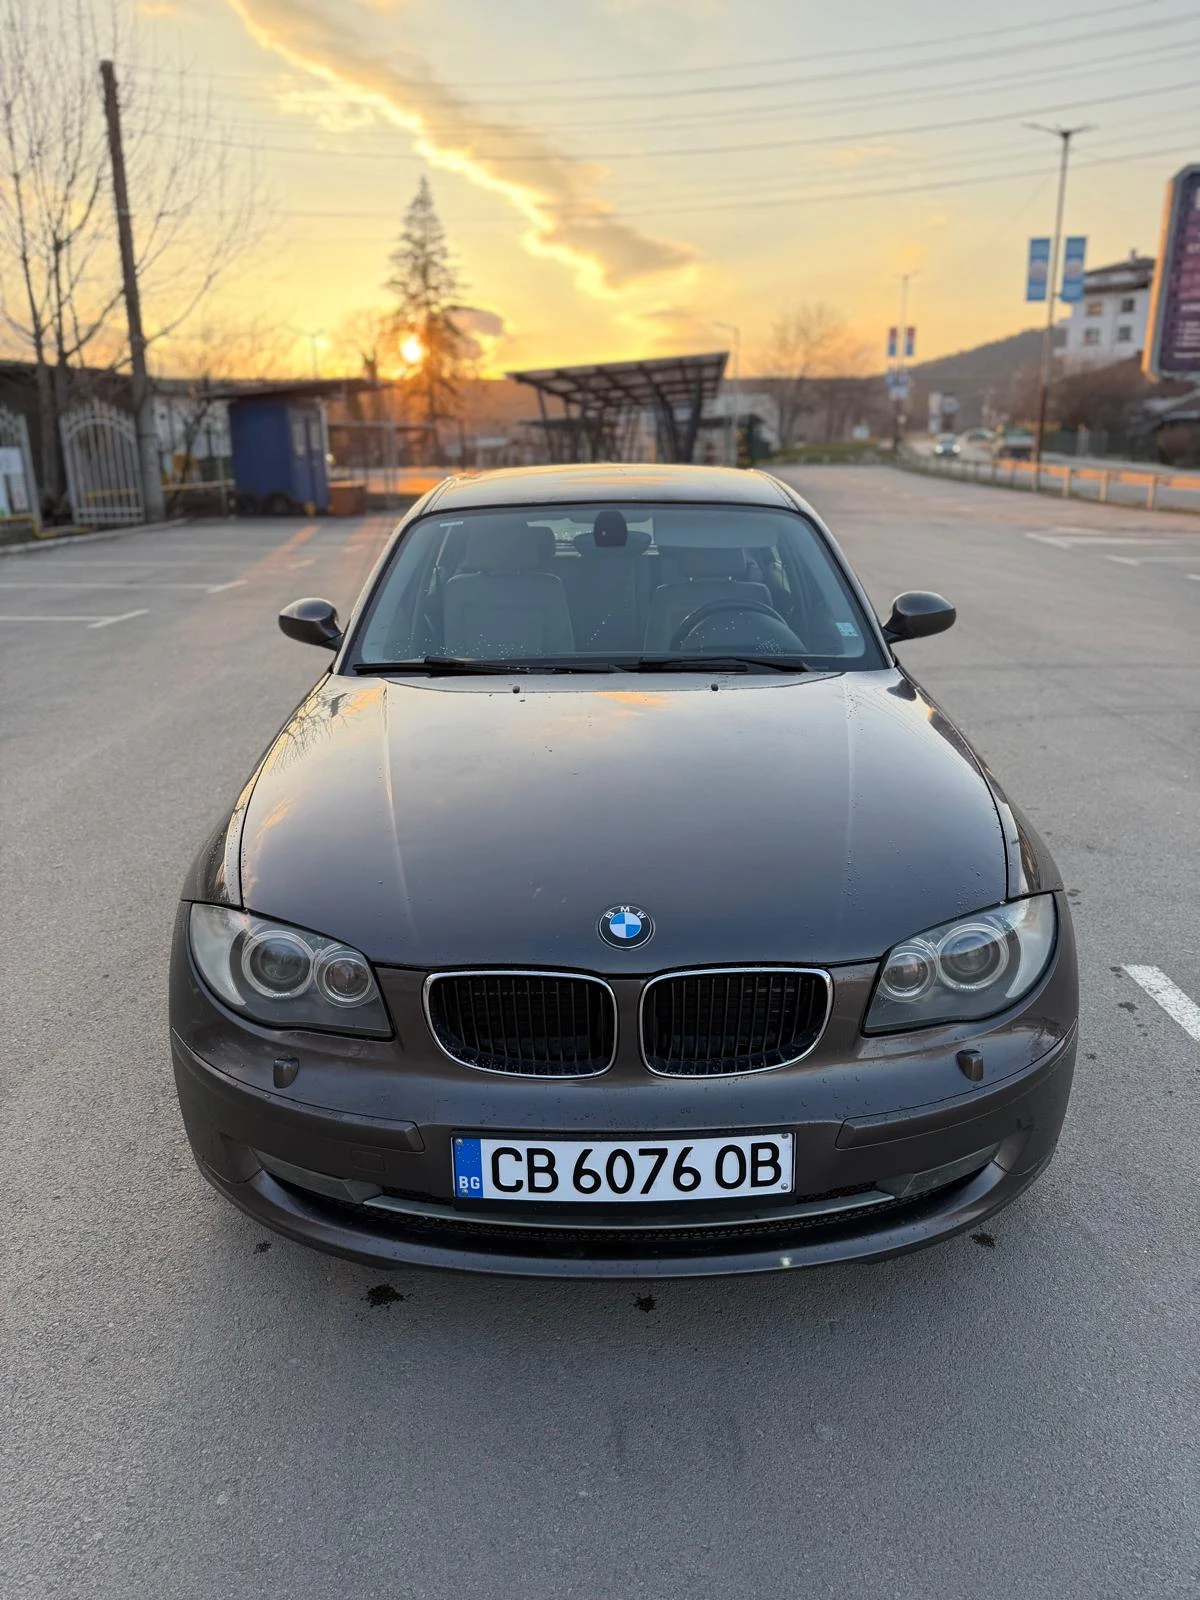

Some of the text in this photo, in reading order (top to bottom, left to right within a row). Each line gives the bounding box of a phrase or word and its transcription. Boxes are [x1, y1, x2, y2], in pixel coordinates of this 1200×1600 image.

[605, 906, 646, 919] BMW
[572, 1146, 701, 1194] 6076
[459, 1176, 480, 1189] BG
